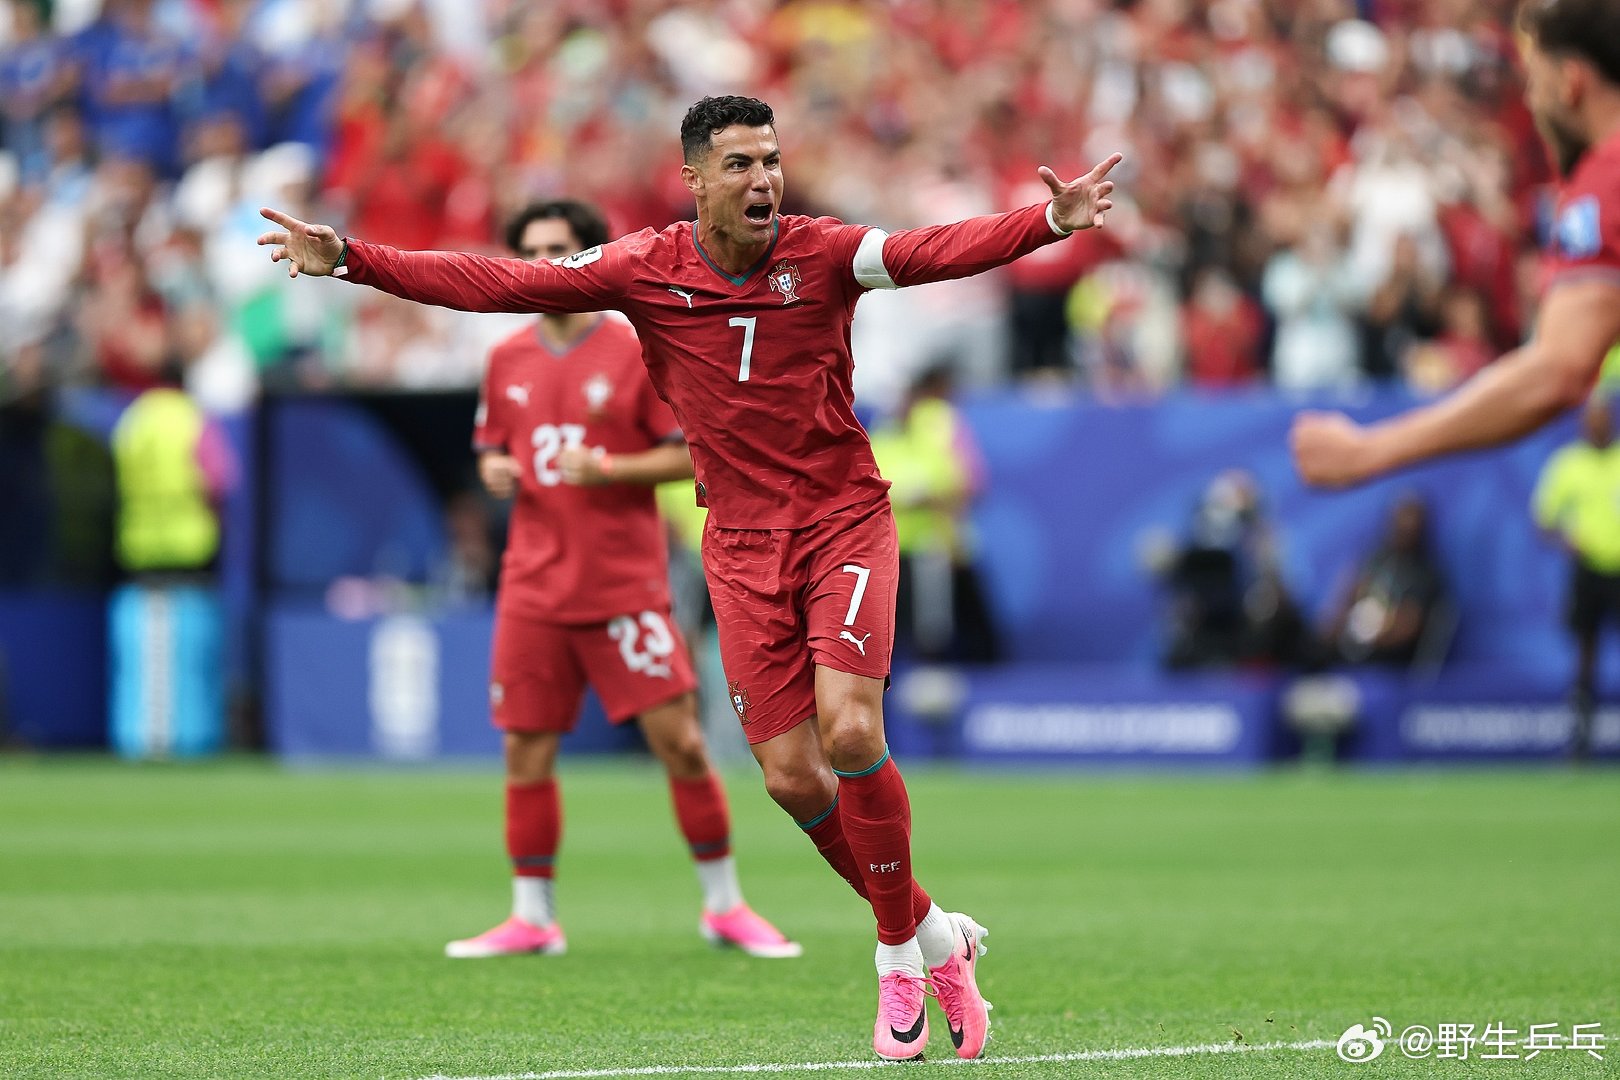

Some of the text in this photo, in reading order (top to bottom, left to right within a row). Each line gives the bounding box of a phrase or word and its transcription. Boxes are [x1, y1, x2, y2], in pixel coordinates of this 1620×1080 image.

[728, 316, 757, 383] 7
[842, 565, 870, 626] 7
[608, 610, 675, 672] 23
